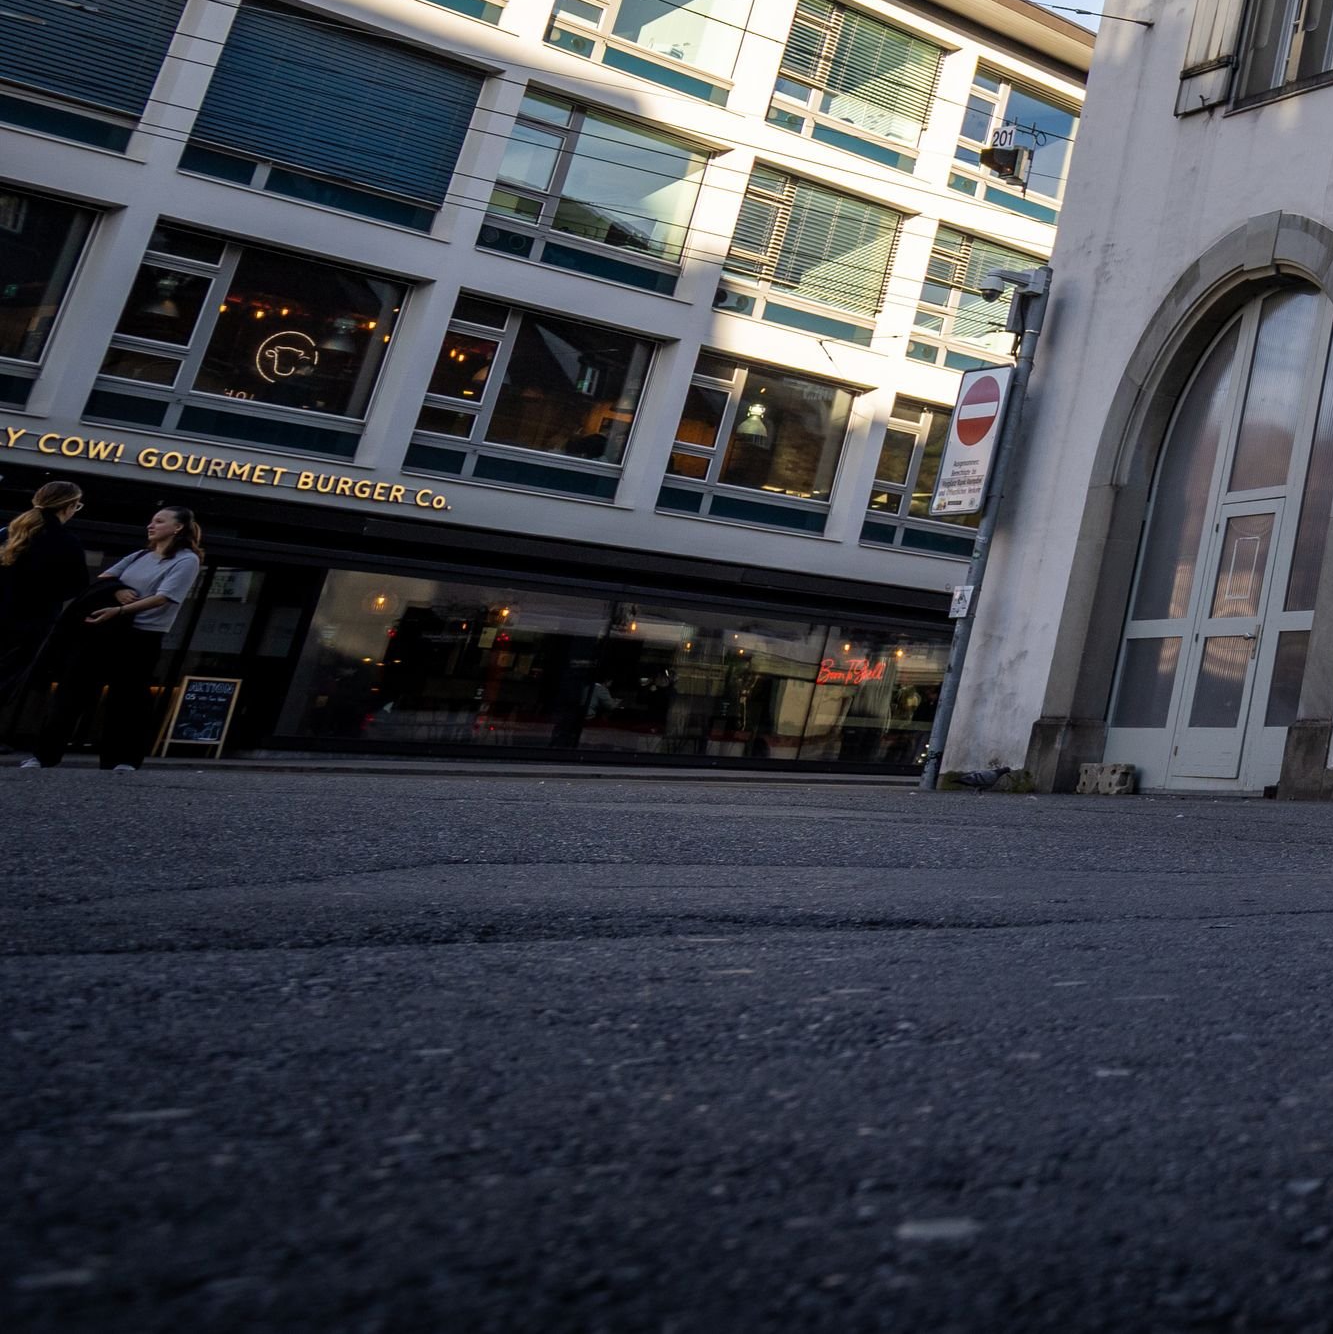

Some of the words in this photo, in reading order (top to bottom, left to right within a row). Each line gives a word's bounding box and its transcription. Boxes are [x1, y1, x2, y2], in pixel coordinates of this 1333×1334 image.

[992, 129, 1014, 147] 201
[0, 426, 26, 448] Y
[38, 433, 125, 463] COW!
[137, 447, 288, 486] GOURMET
[296, 470, 406, 503] BURGER
[415, 489, 452, 510] Co.
[816, 658, 845, 685] Born
